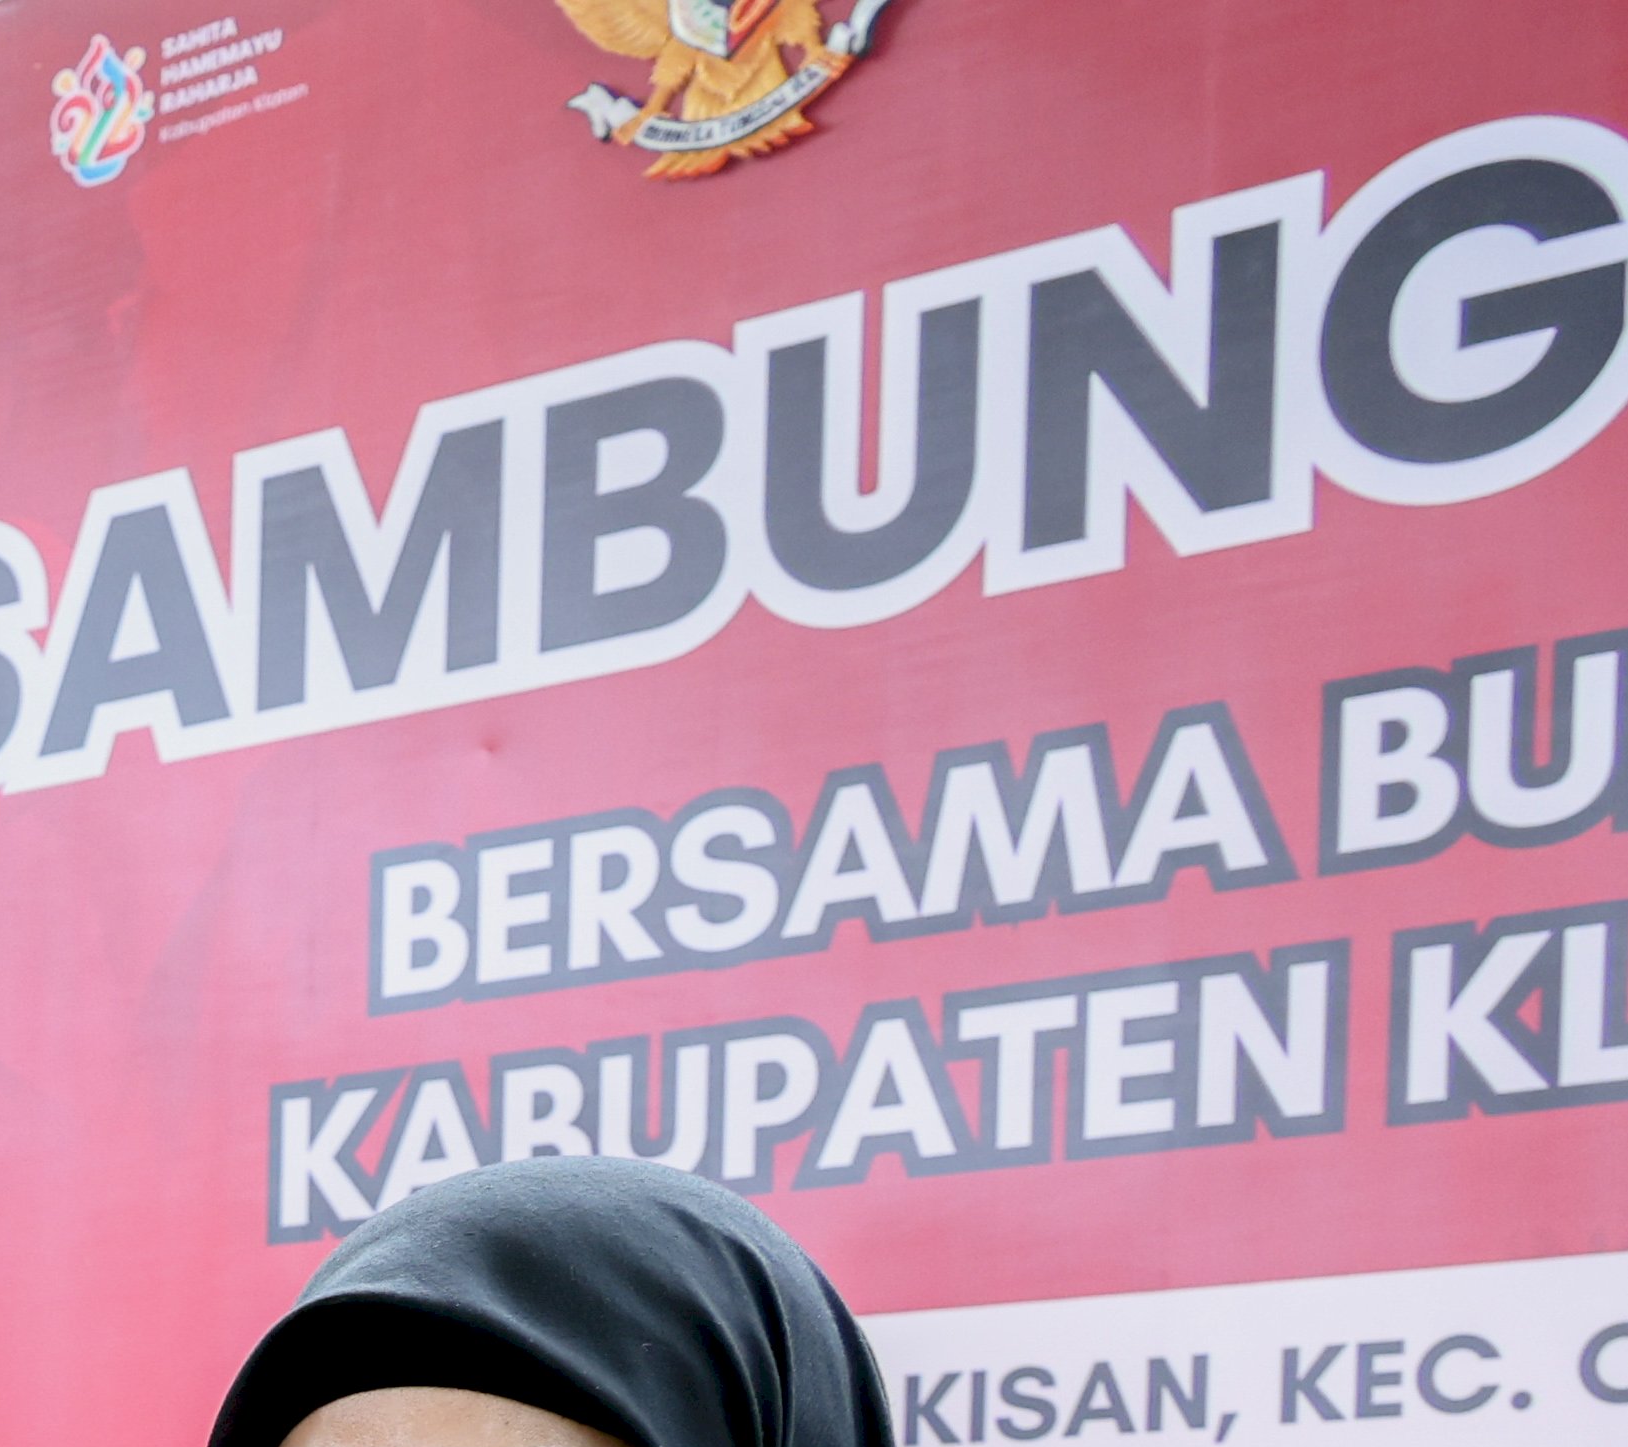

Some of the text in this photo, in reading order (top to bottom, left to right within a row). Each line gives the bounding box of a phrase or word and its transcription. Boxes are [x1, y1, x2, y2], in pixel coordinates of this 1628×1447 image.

[373, 706, 1283, 1008] BERSAMA
[277, 950, 1337, 1234] KABUPATEN
[1279, 1333, 1534, 1425] KEC.
